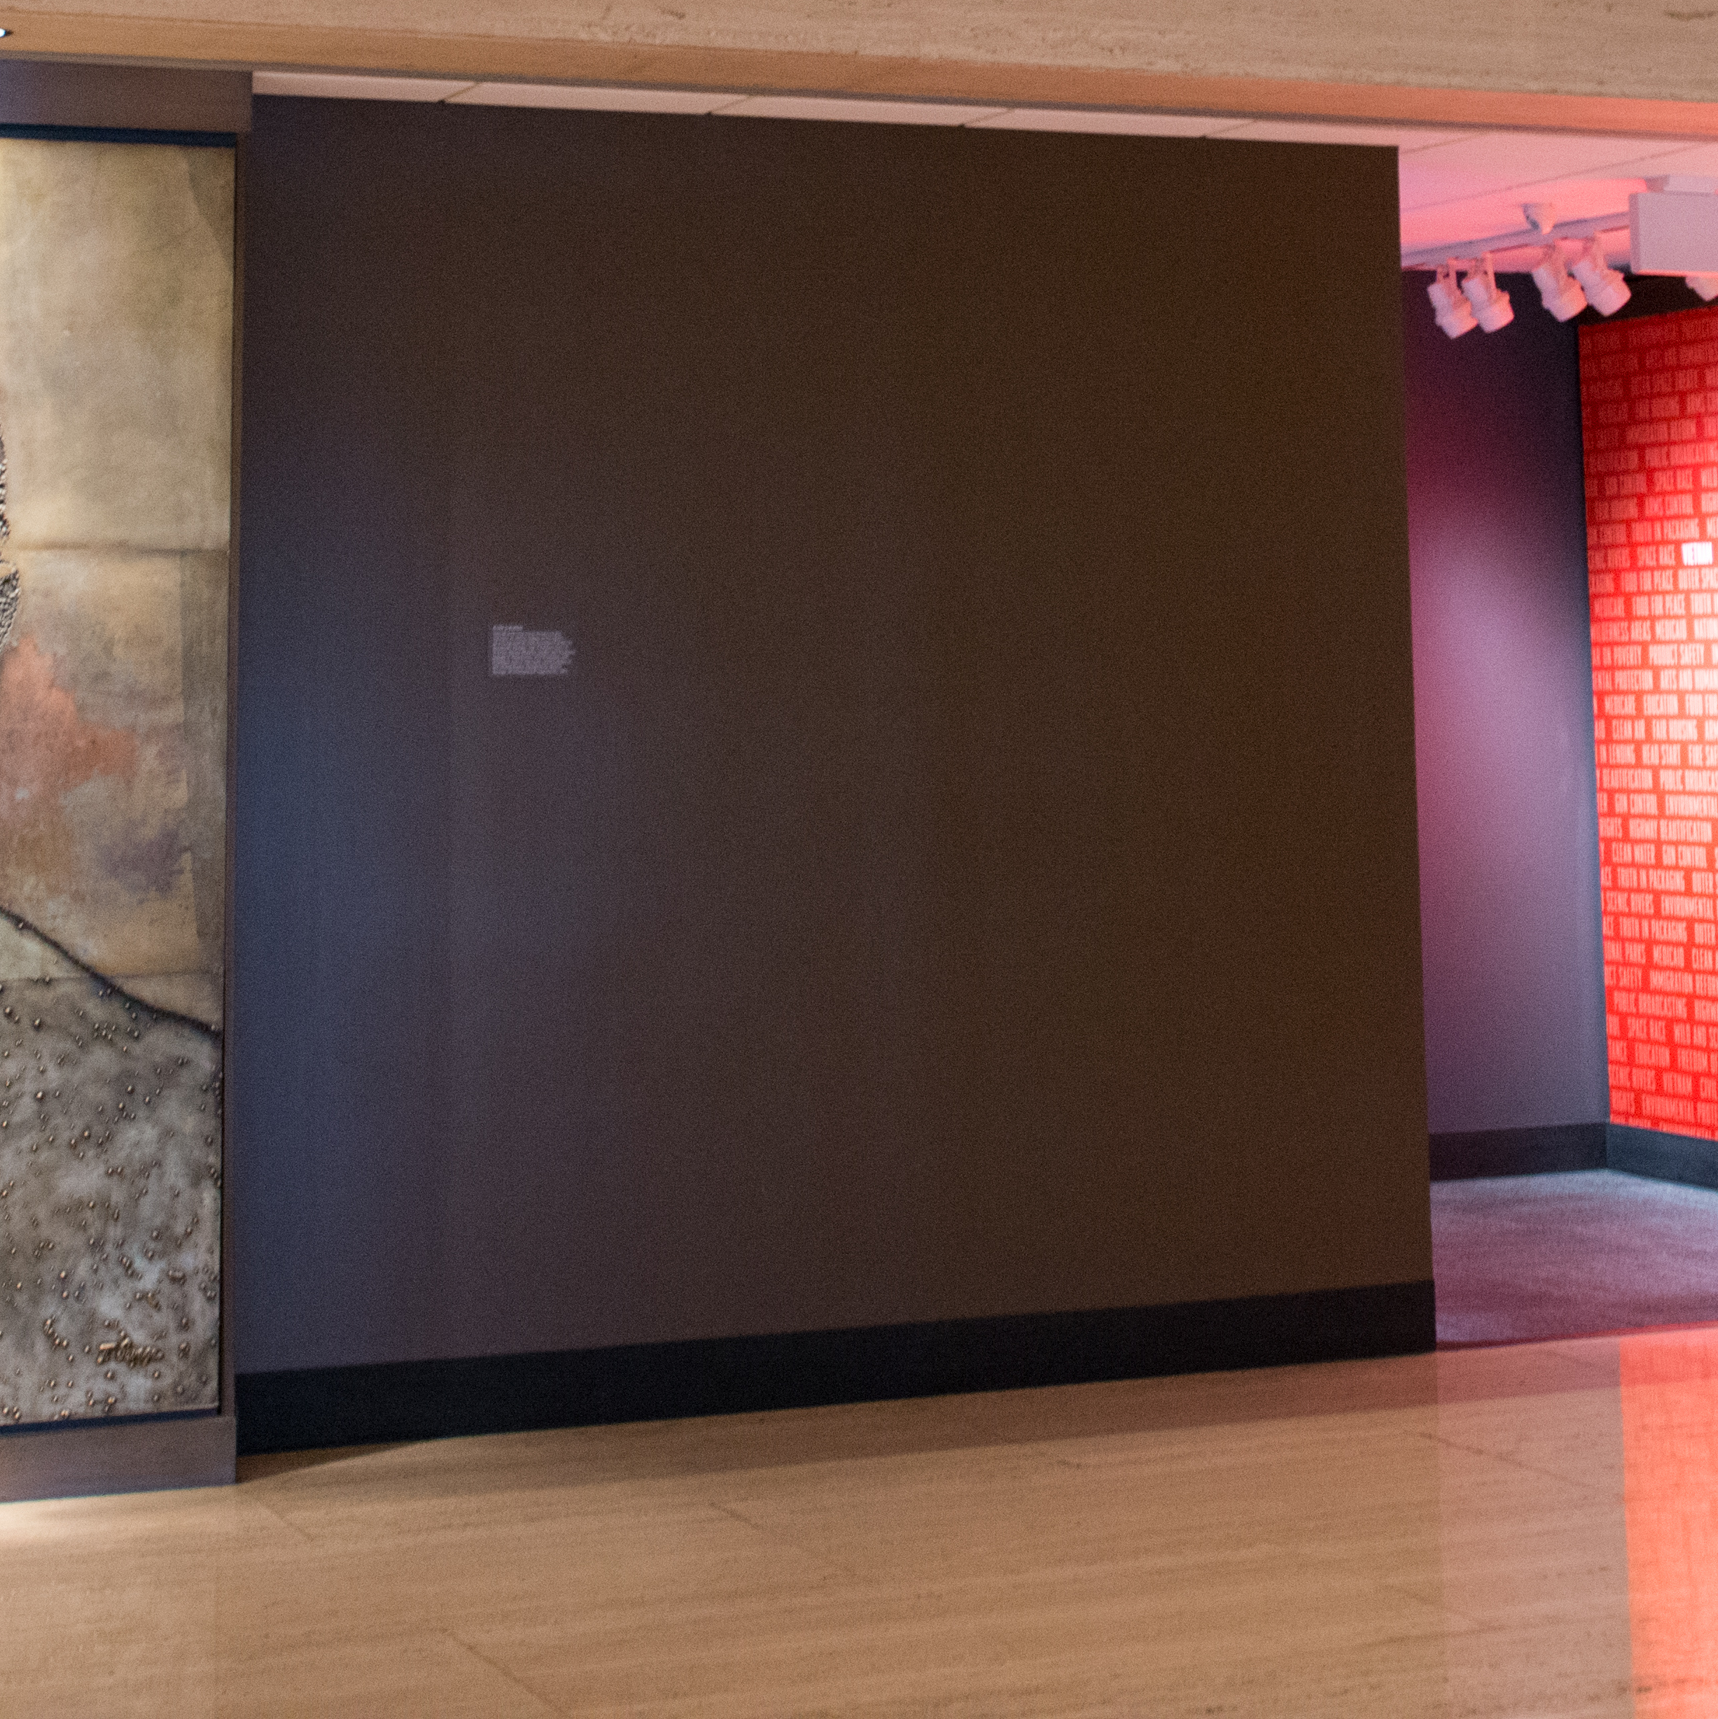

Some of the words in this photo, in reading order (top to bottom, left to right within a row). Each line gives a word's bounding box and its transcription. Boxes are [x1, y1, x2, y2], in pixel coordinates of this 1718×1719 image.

[1681, 541, 1713, 564] VIETNAM
[1641, 744, 1659, 765] HEAD
[1660, 744, 1681, 766] START
[1687, 744, 1703, 766] FIRE
[1658, 769, 1682, 791] PUBLIC
